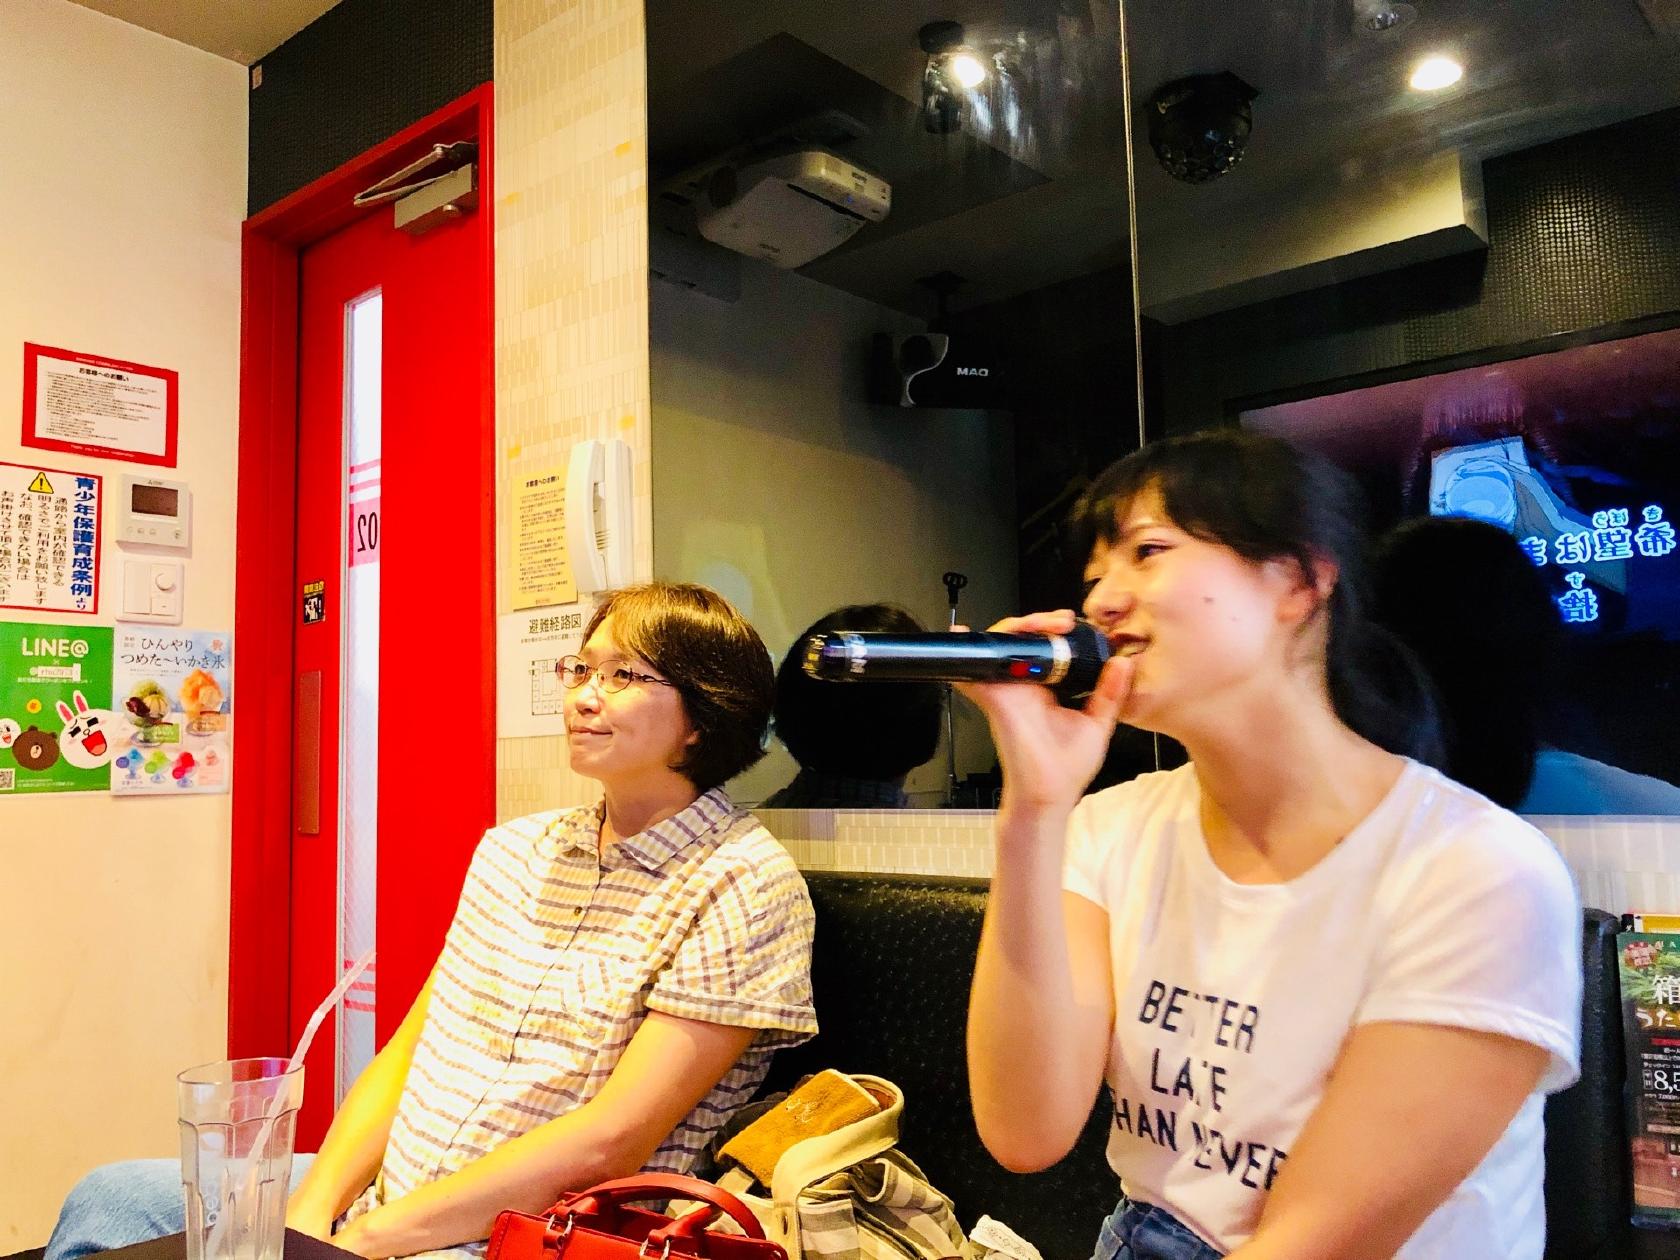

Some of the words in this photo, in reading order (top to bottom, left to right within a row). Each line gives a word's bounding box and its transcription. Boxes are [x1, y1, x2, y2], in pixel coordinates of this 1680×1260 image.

[141, 637, 193, 653] ひんやり
[528, 613, 582, 634] 避難経路図
[21, 636, 89, 658] LINE@
[1139, 980, 1259, 1054] BETER
[1151, 1047, 1227, 1111] LAE
[1108, 1086, 1178, 1152] HAN
